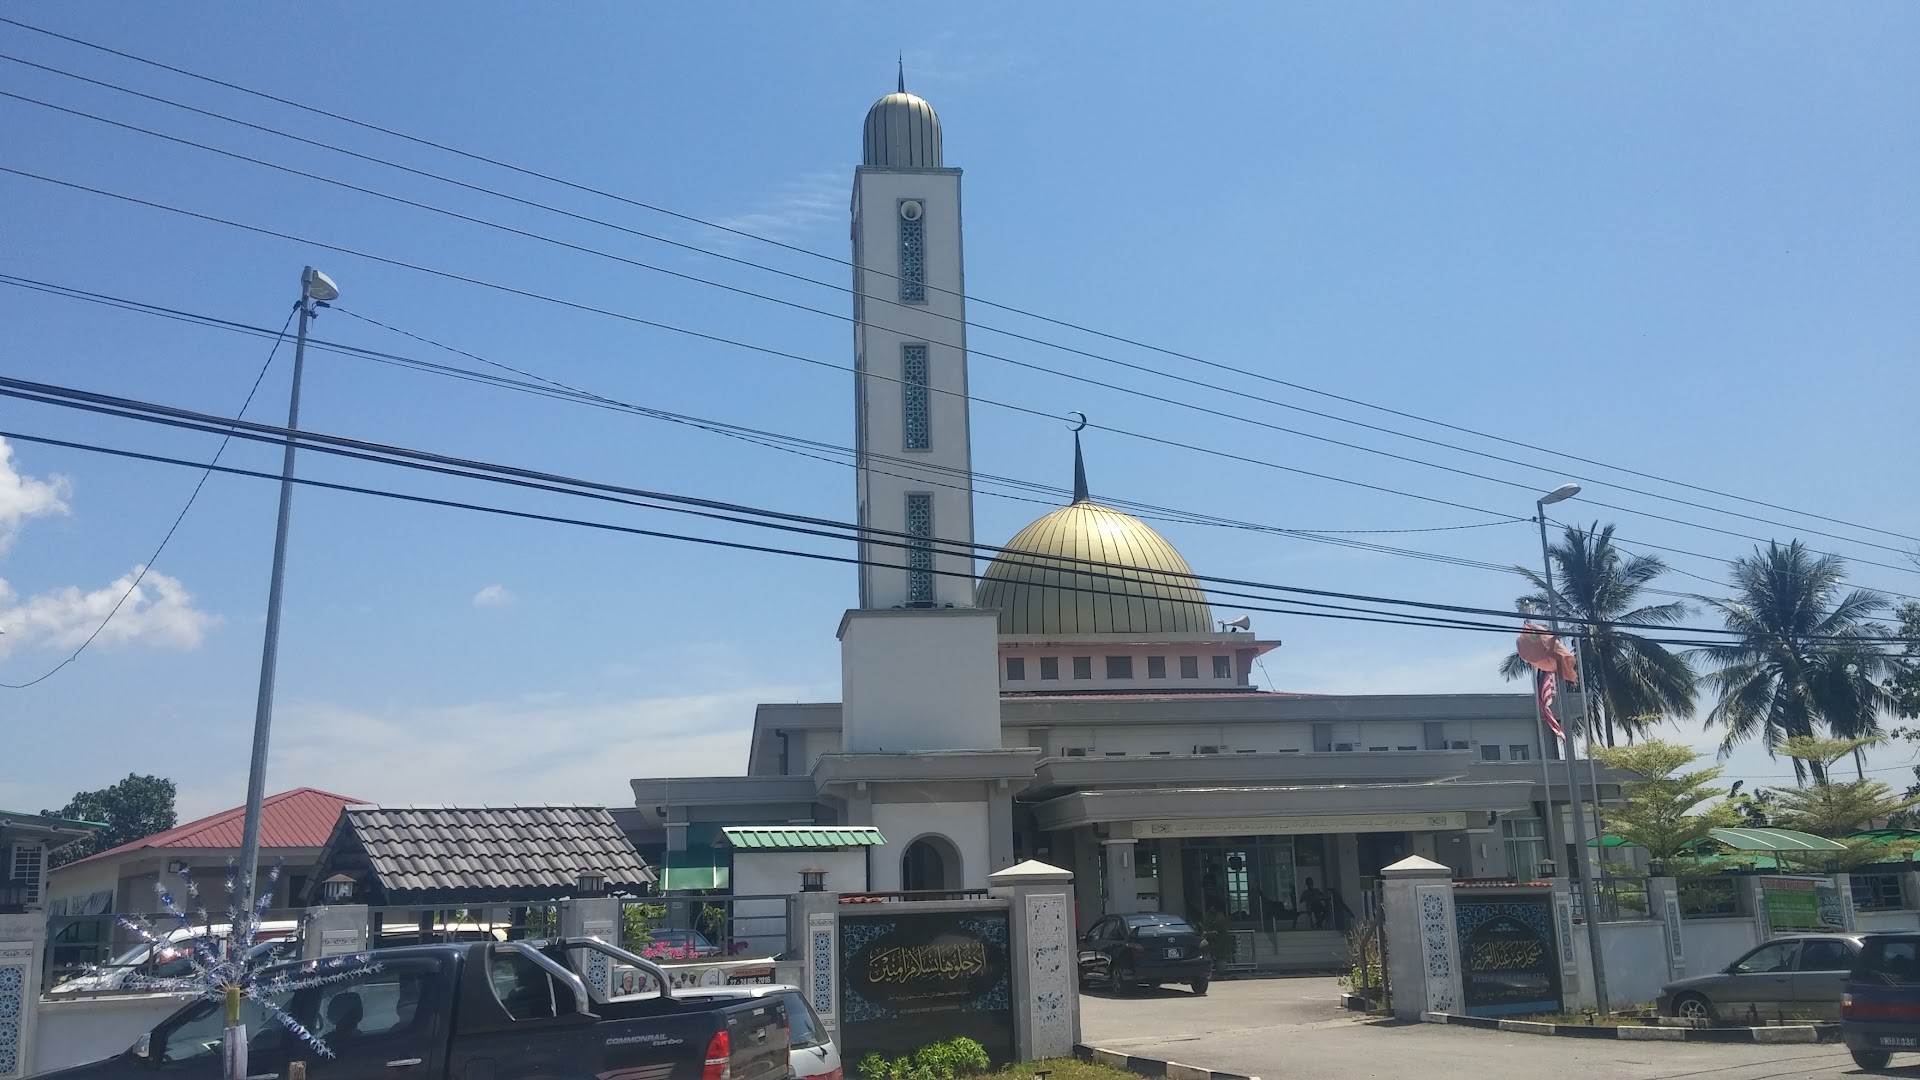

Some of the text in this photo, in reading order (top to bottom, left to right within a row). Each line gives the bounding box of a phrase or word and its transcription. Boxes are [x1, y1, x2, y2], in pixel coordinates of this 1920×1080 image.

[758, 976, 771, 984] 2016
[605, 1033, 667, 1046] COMMONRAIL
[652, 1038, 684, 1047] turbo
